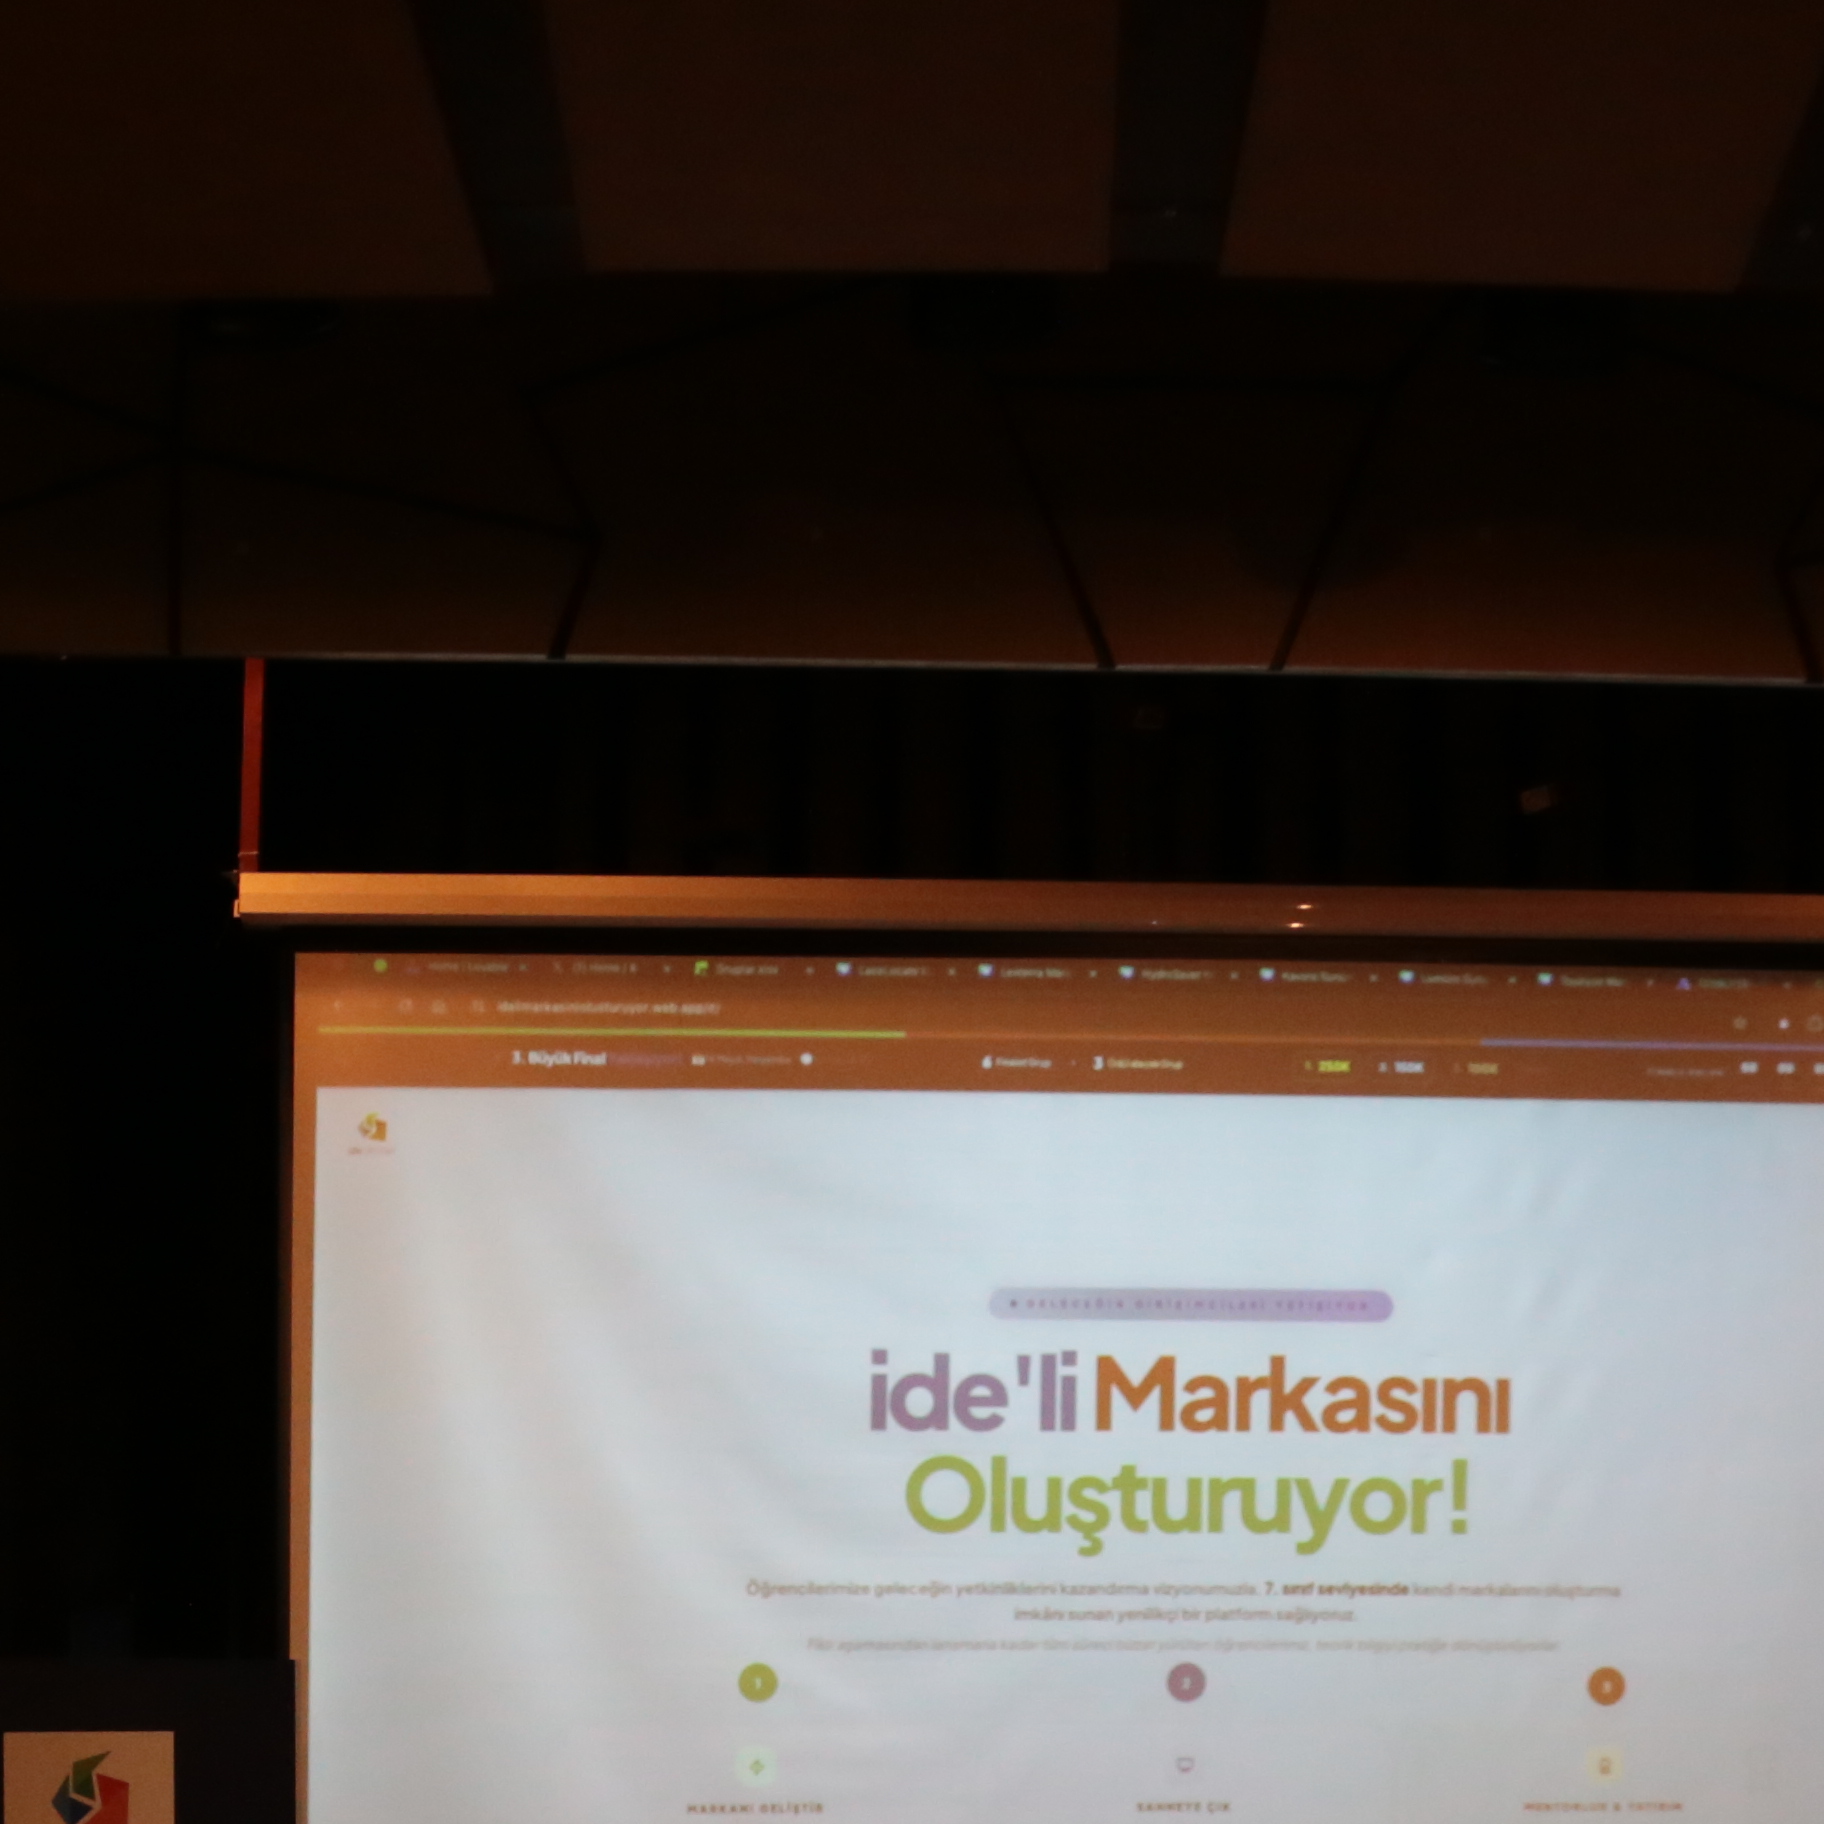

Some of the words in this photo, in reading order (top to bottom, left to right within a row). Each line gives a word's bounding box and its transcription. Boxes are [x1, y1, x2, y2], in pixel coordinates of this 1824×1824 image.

[573, 1051, 607, 1066] Final
[869, 1348, 1078, 1433] ide'li
[1096, 1353, 1510, 1435] Markasını
[906, 1455, 1469, 1557] Oluşturuyor!
[874, 1580, 952, 1599] geleceğin
[1318, 1582, 1410, 1600] seviyesinde
[1204, 1608, 1274, 1624] platform
